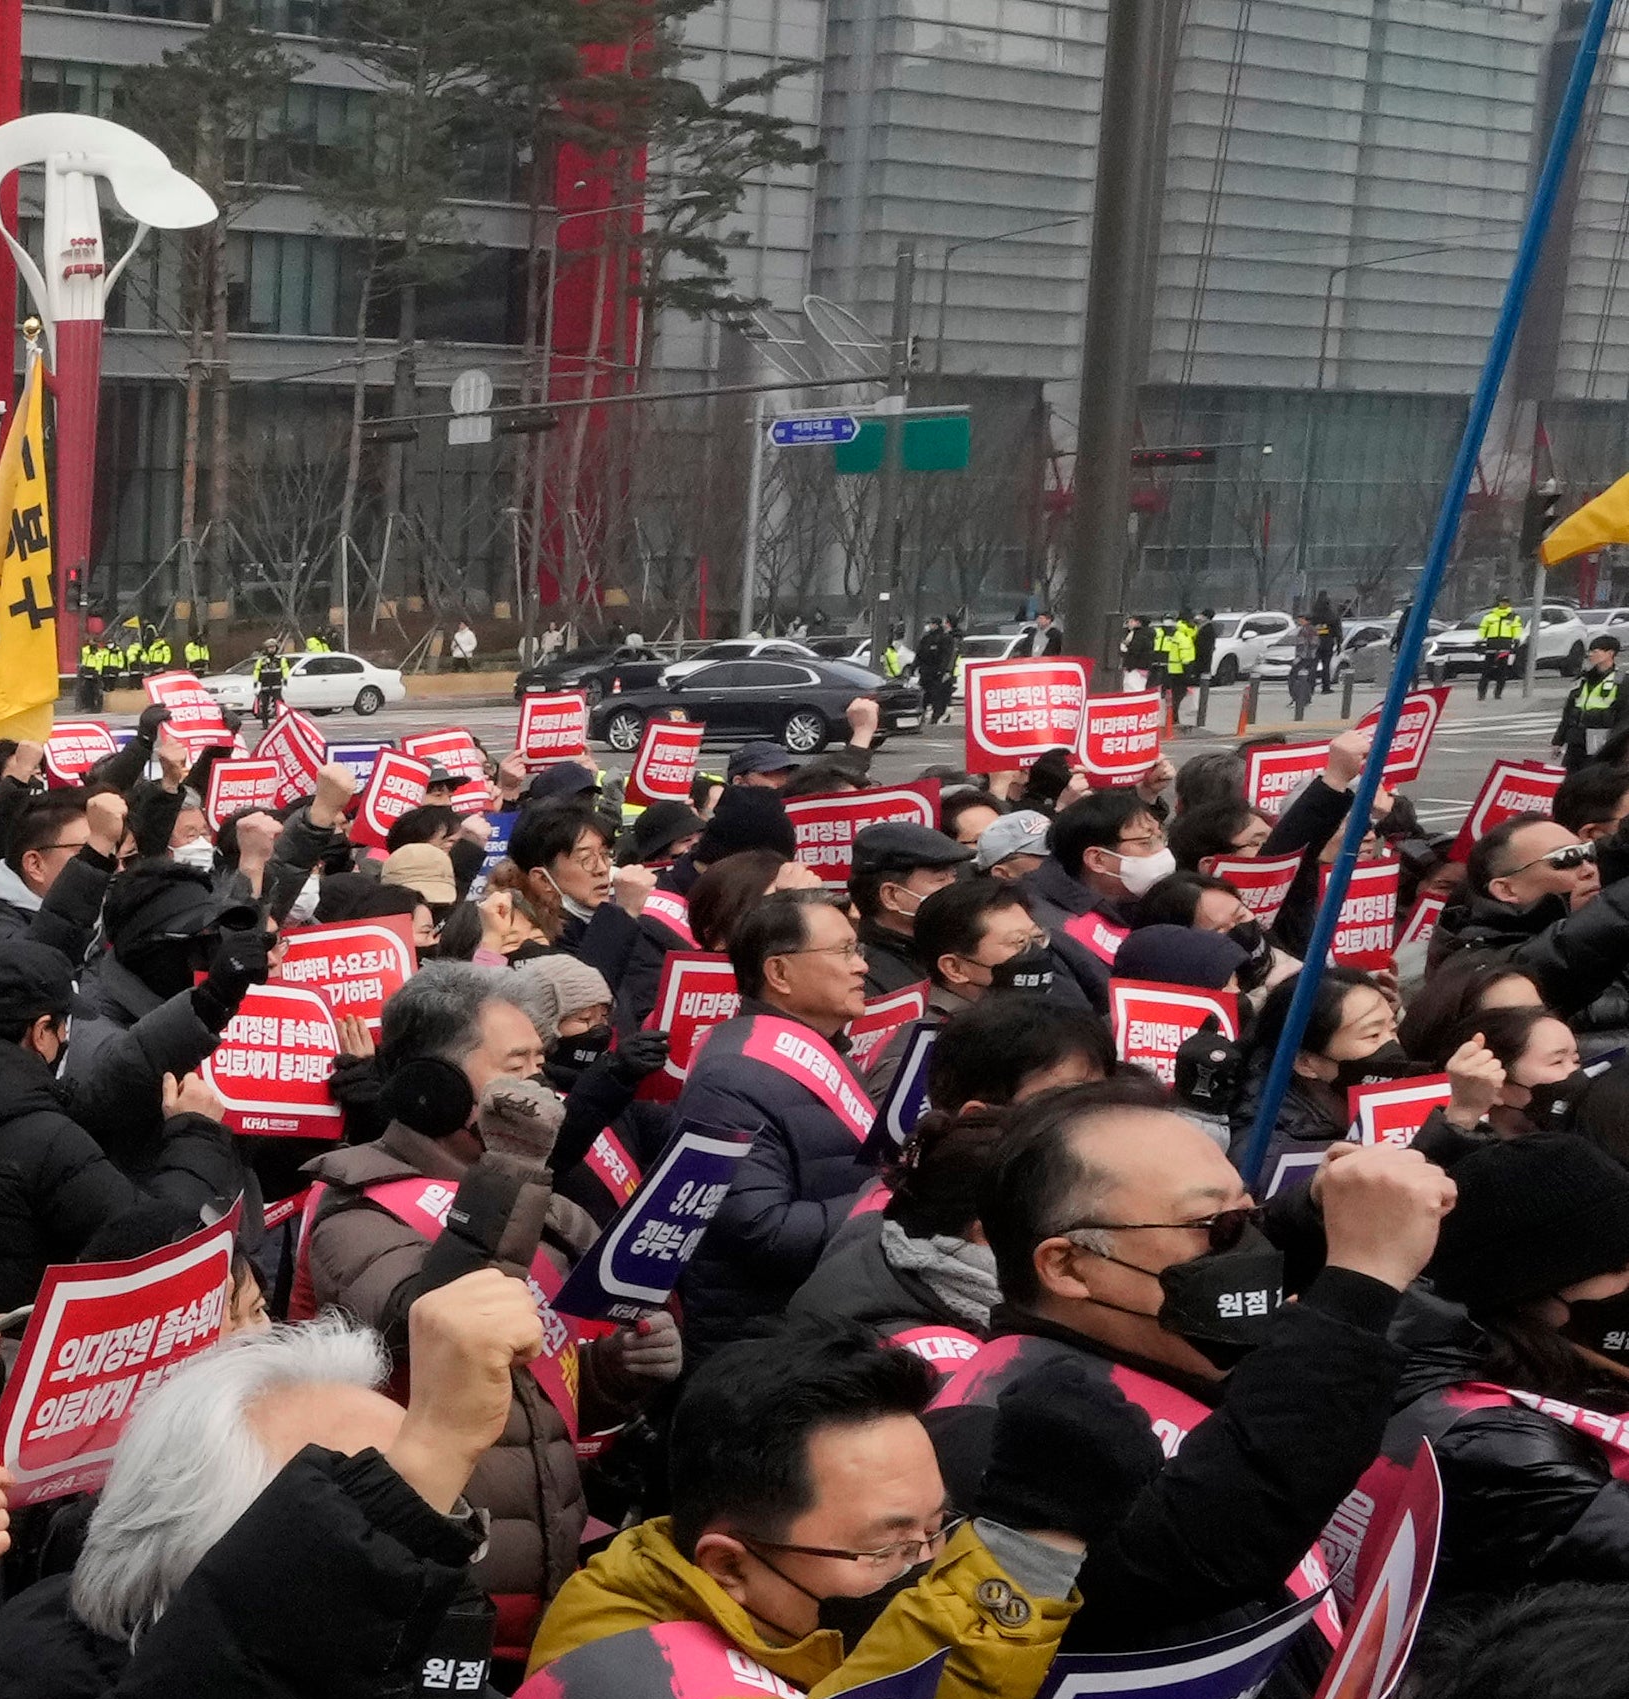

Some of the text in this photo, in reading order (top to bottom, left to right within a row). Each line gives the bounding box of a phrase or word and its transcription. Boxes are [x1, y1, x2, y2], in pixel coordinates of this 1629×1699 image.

[984, 685, 1048, 709] 일방적인
[985, 709, 1049, 735] 국민건강
[282, 949, 396, 984] 비과학적 수요조사
[1013, 971, 1044, 988] 원점
[215, 1049, 278, 1077] 의료체계
[773, 1030, 846, 1097] 의대정원
[241, 1116, 269, 1131] KMA
[1216, 1291, 1269, 1320] 원점
[48, 1312, 162, 1385] 의대정원
[28, 1375, 142, 1443] 의료체계
[421, 1656, 487, 1691] 원점
